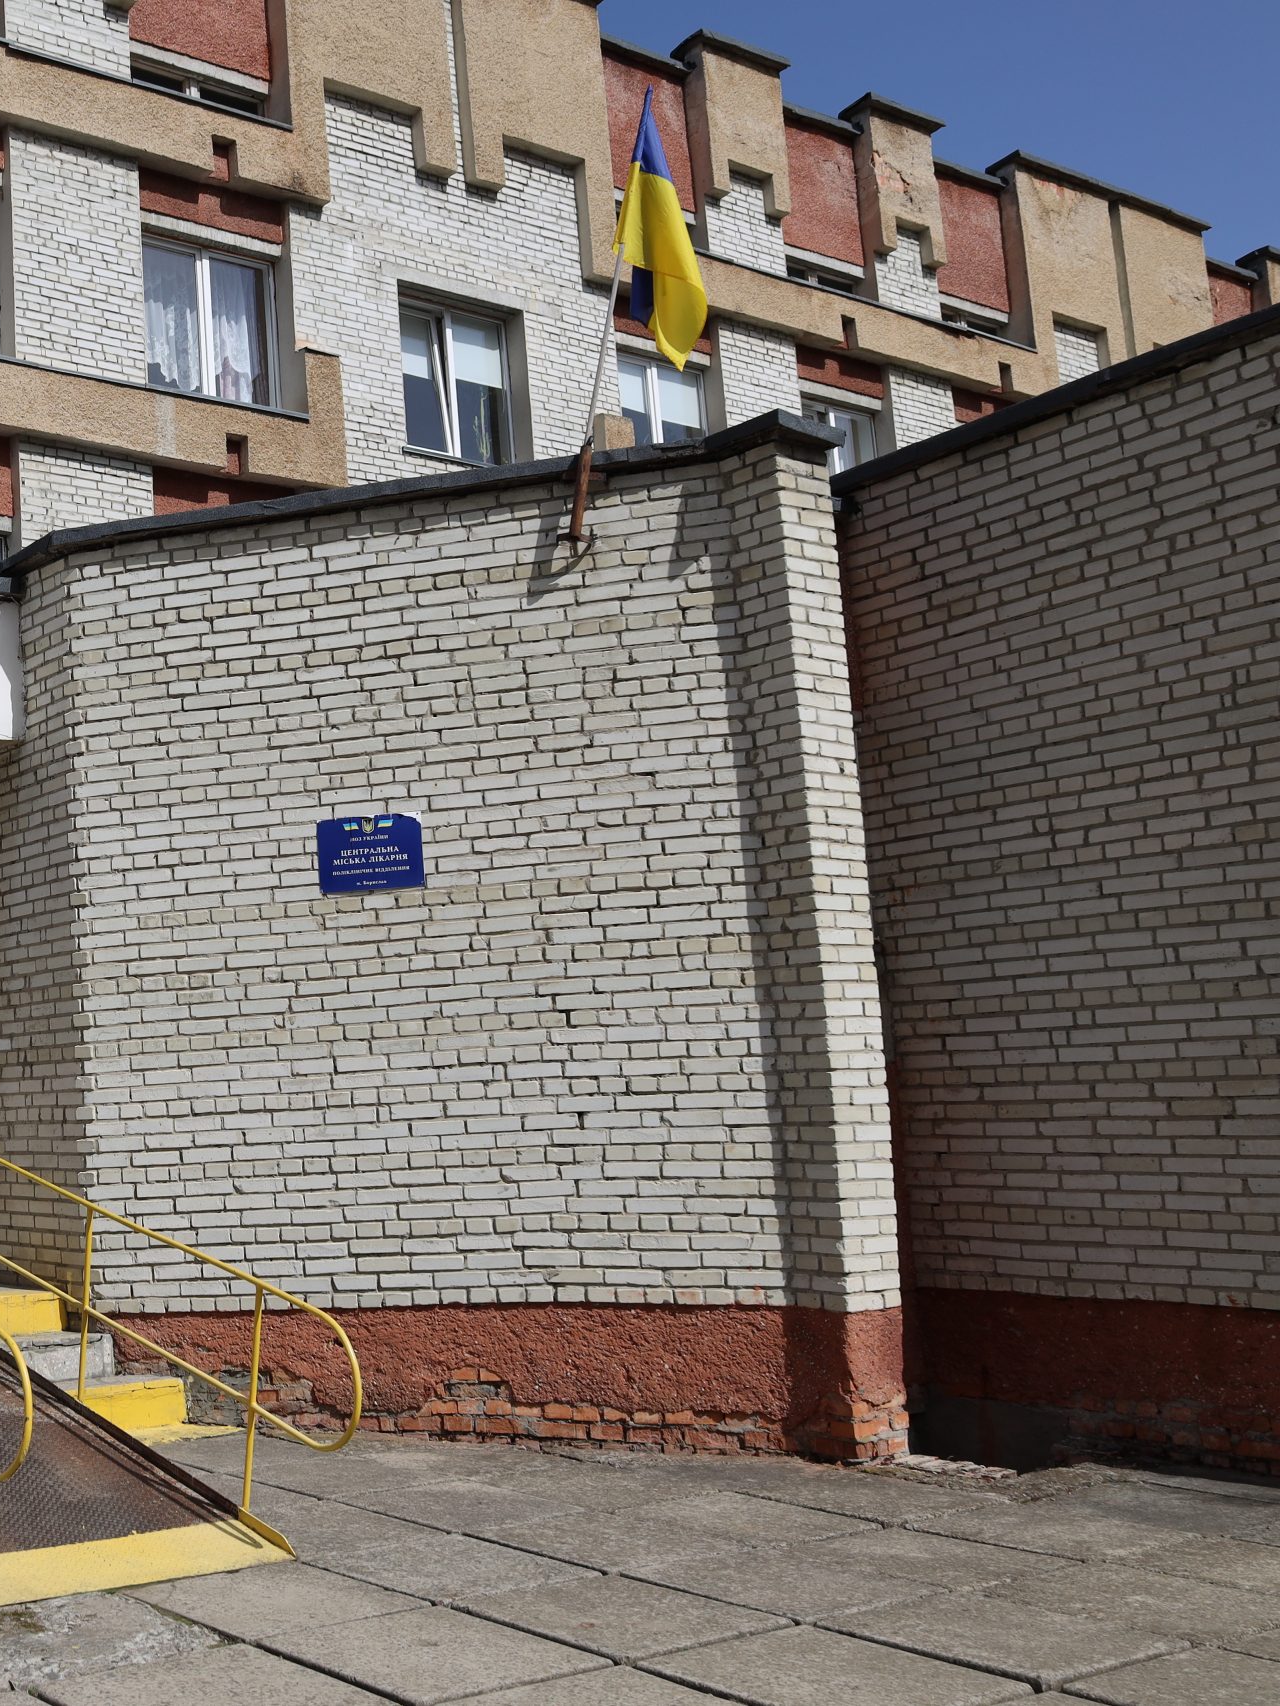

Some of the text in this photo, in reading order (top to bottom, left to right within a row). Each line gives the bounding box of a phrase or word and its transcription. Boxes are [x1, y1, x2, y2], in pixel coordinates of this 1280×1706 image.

[341, 846, 399, 857] ЦЕНТРАЛЬНА
[333, 853, 409, 866] МІСЬКА ЛІКАРНЯ
